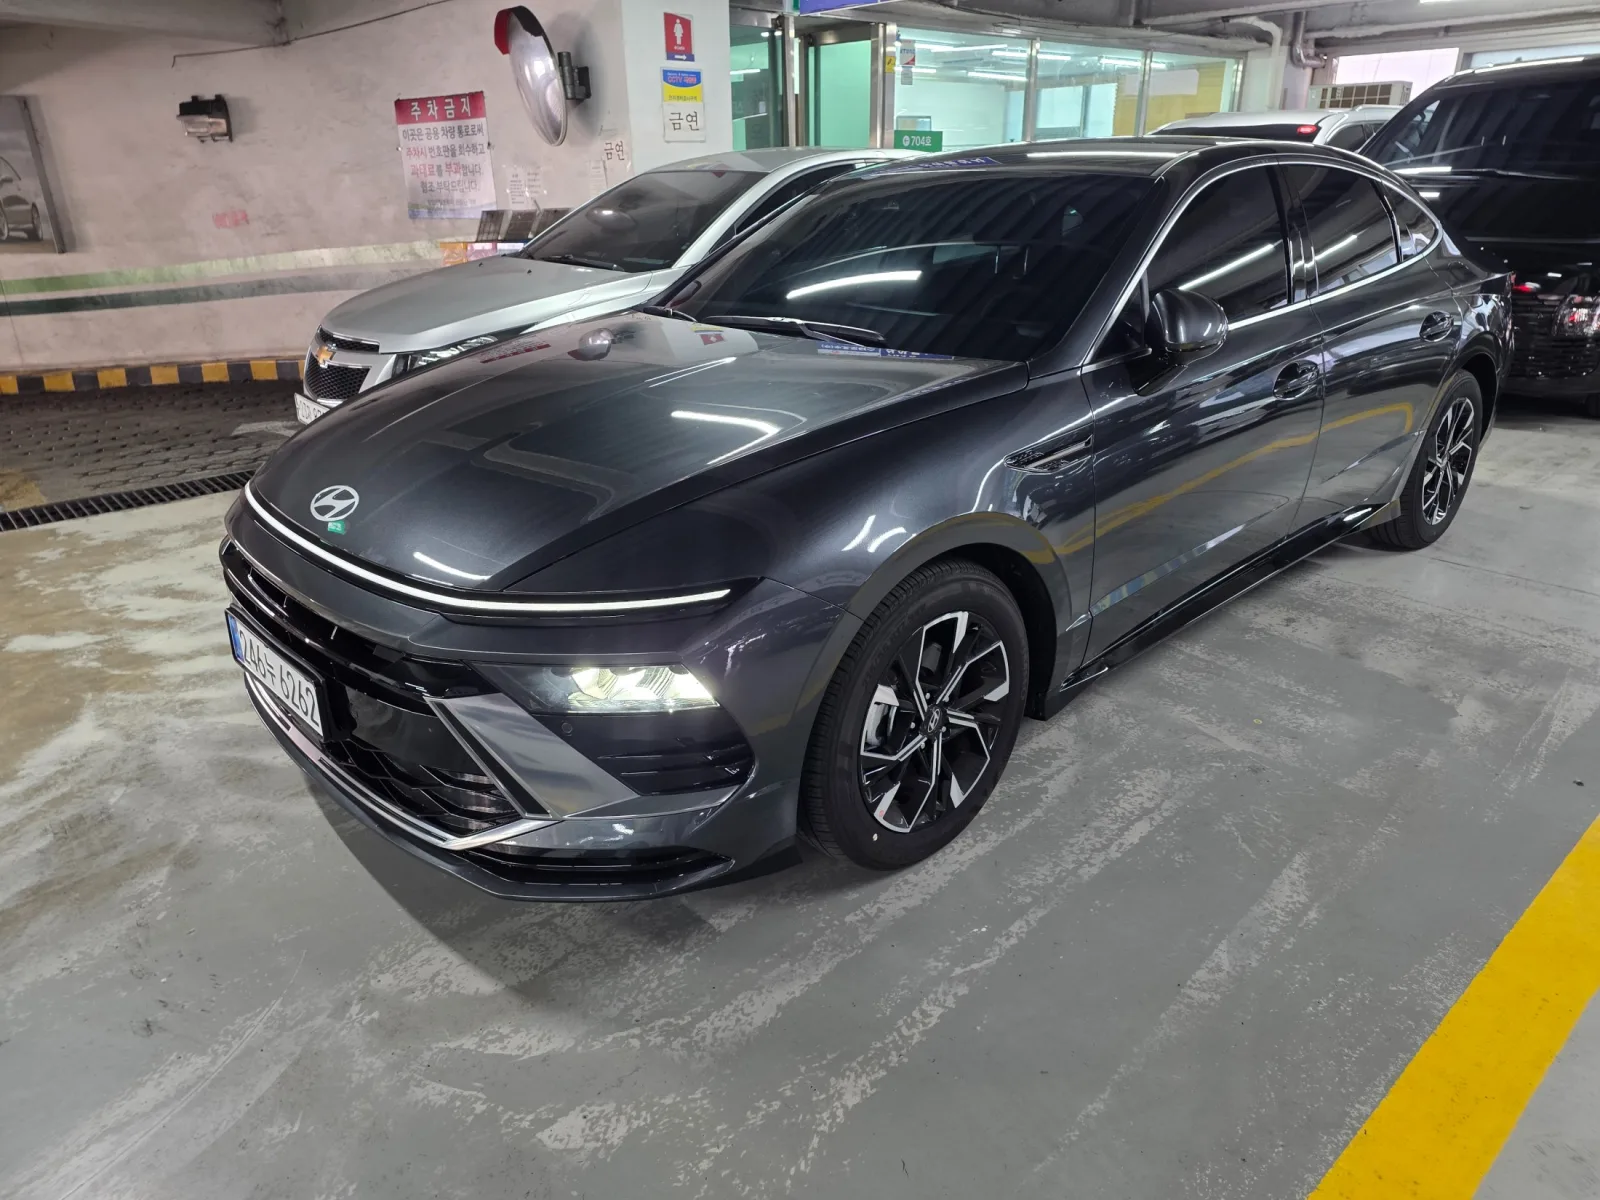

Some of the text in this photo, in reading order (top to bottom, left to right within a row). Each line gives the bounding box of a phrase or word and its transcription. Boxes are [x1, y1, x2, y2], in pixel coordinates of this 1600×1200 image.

[411, 95, 471, 121] 주차금지
[668, 110, 700, 131] 금연
[402, 127, 425, 142] 이곳은
[425, 126, 440, 140] 공용
[441, 125, 456, 140] 차량
[406, 143, 486, 160] 주차시 번호판을 회수하고
[604, 140, 625, 160] 금연
[410, 163, 443, 178] 과태료를
[421, 181, 435, 193] 협조
[239, 629, 320, 728] 246누 6262
